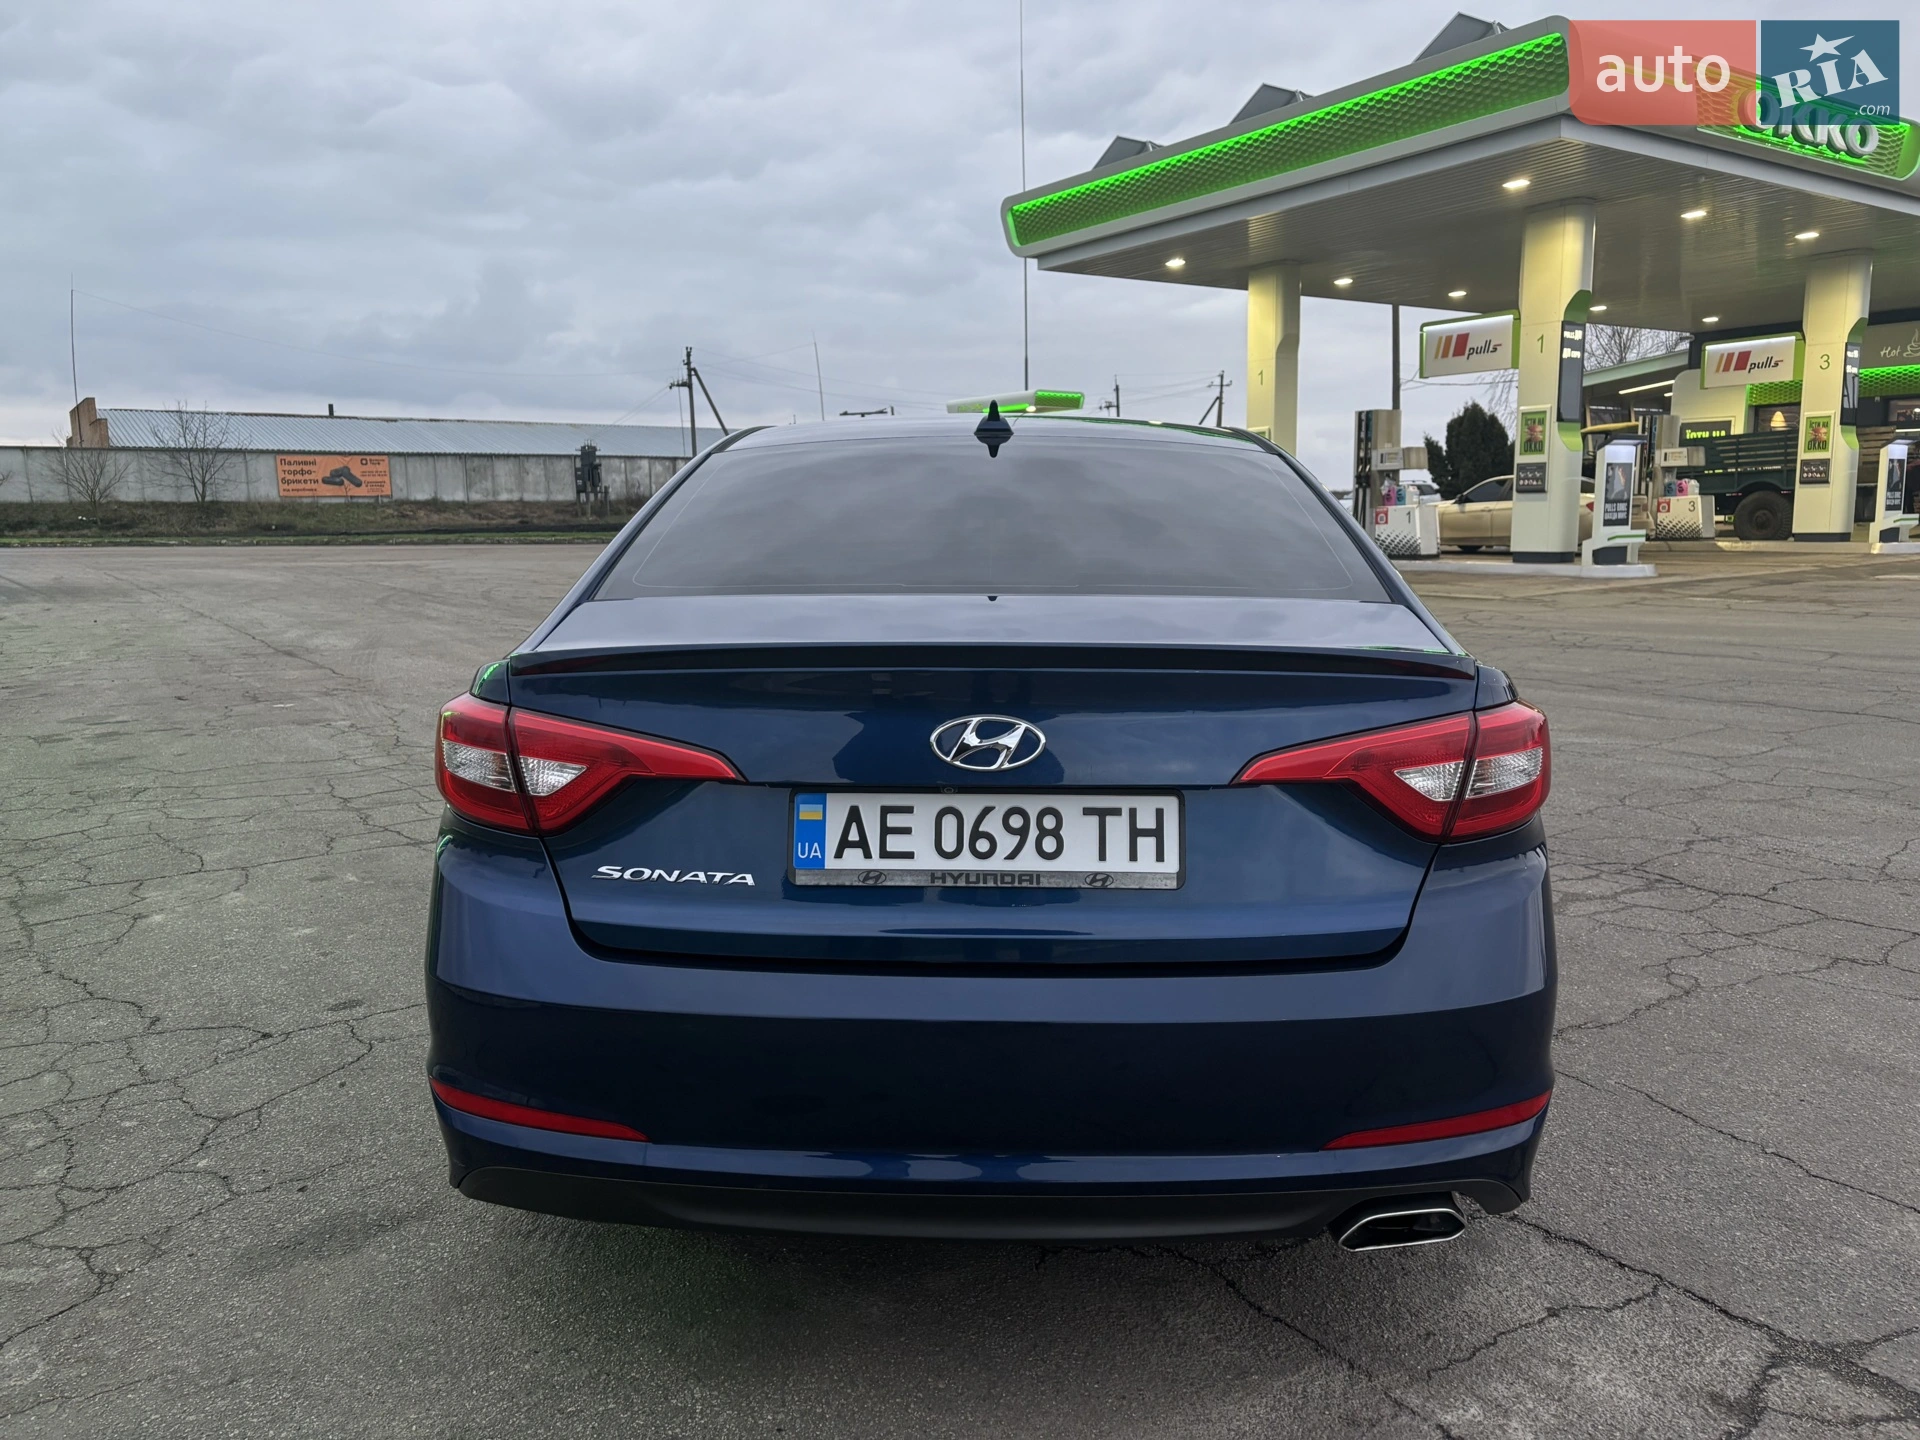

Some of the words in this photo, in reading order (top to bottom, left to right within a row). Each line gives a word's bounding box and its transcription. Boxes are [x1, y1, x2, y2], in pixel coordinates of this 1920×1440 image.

[1739, 91, 1879, 156] OKKO
[1466, 339, 1503, 360] pulls
[1537, 333, 1544, 353] 1
[1880, 345, 1901, 358] Hot
[1747, 355, 1784, 374] pulls
[1819, 353, 1831, 370] 3
[1257, 369, 1264, 386] 1
[280, 458, 317, 466] Паливні
[282, 467, 316, 476] торфо-
[280, 477, 319, 486] брикети
[1688, 500, 1696, 512] 3
[833, 805, 915, 859] AE
[934, 806, 1064, 861] 0698
[1082, 807, 1165, 862] TH
[798, 842, 822, 859] UA
[591, 865, 756, 886] SONATA
[930, 872, 1041, 886] HYUNDAI
